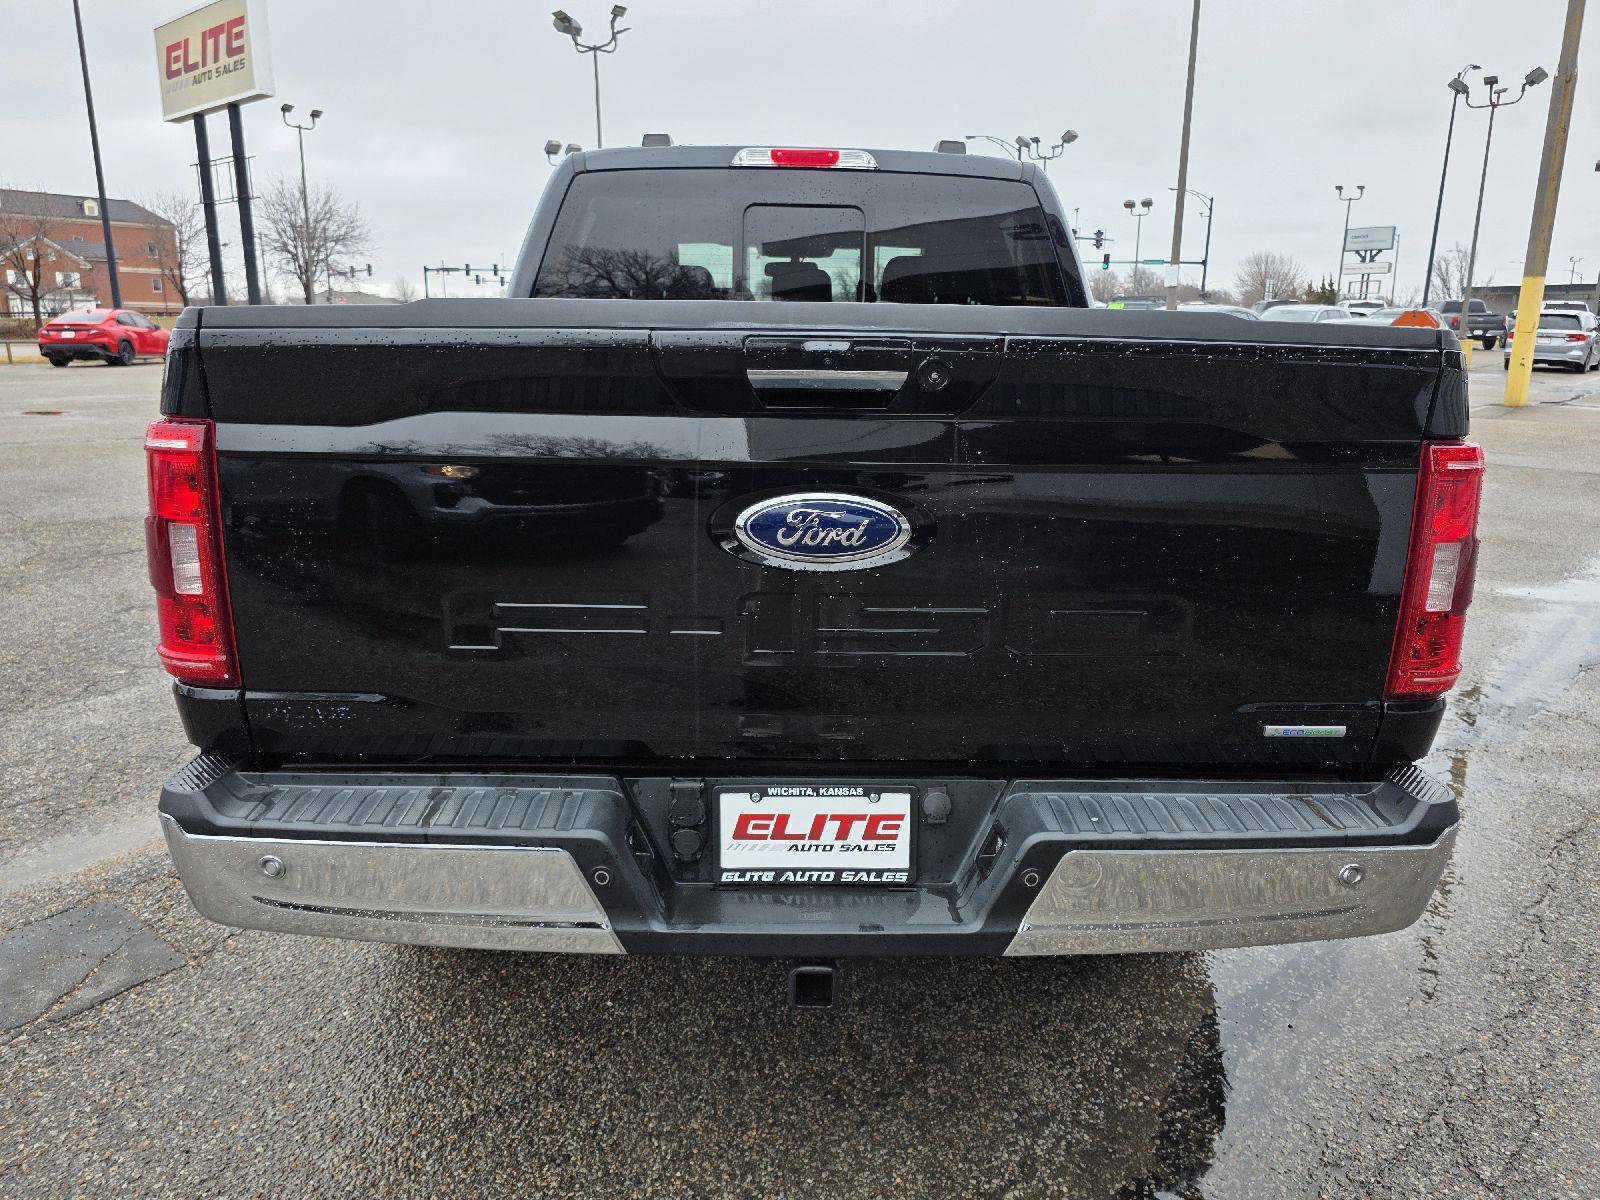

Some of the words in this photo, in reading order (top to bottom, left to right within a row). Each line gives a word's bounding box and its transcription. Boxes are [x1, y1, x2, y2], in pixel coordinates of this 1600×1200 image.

[165, 15, 245, 80] ELITE
[192, 69, 213, 86] AUTO
[215, 58, 245, 79] SALES
[776, 508, 870, 547] Ford
[442, 592, 1193, 659] F-150
[767, 787, 817, 797] WICHITA,
[819, 787, 864, 796] KANSAS
[732, 813, 906, 841] ELITE
[787, 843, 833, 852] AUTO
[839, 843, 897, 852] SALES
[721, 872, 774, 882] ELITE
[780, 871, 836, 882] AUTO
[841, 871, 909, 882] SALES
